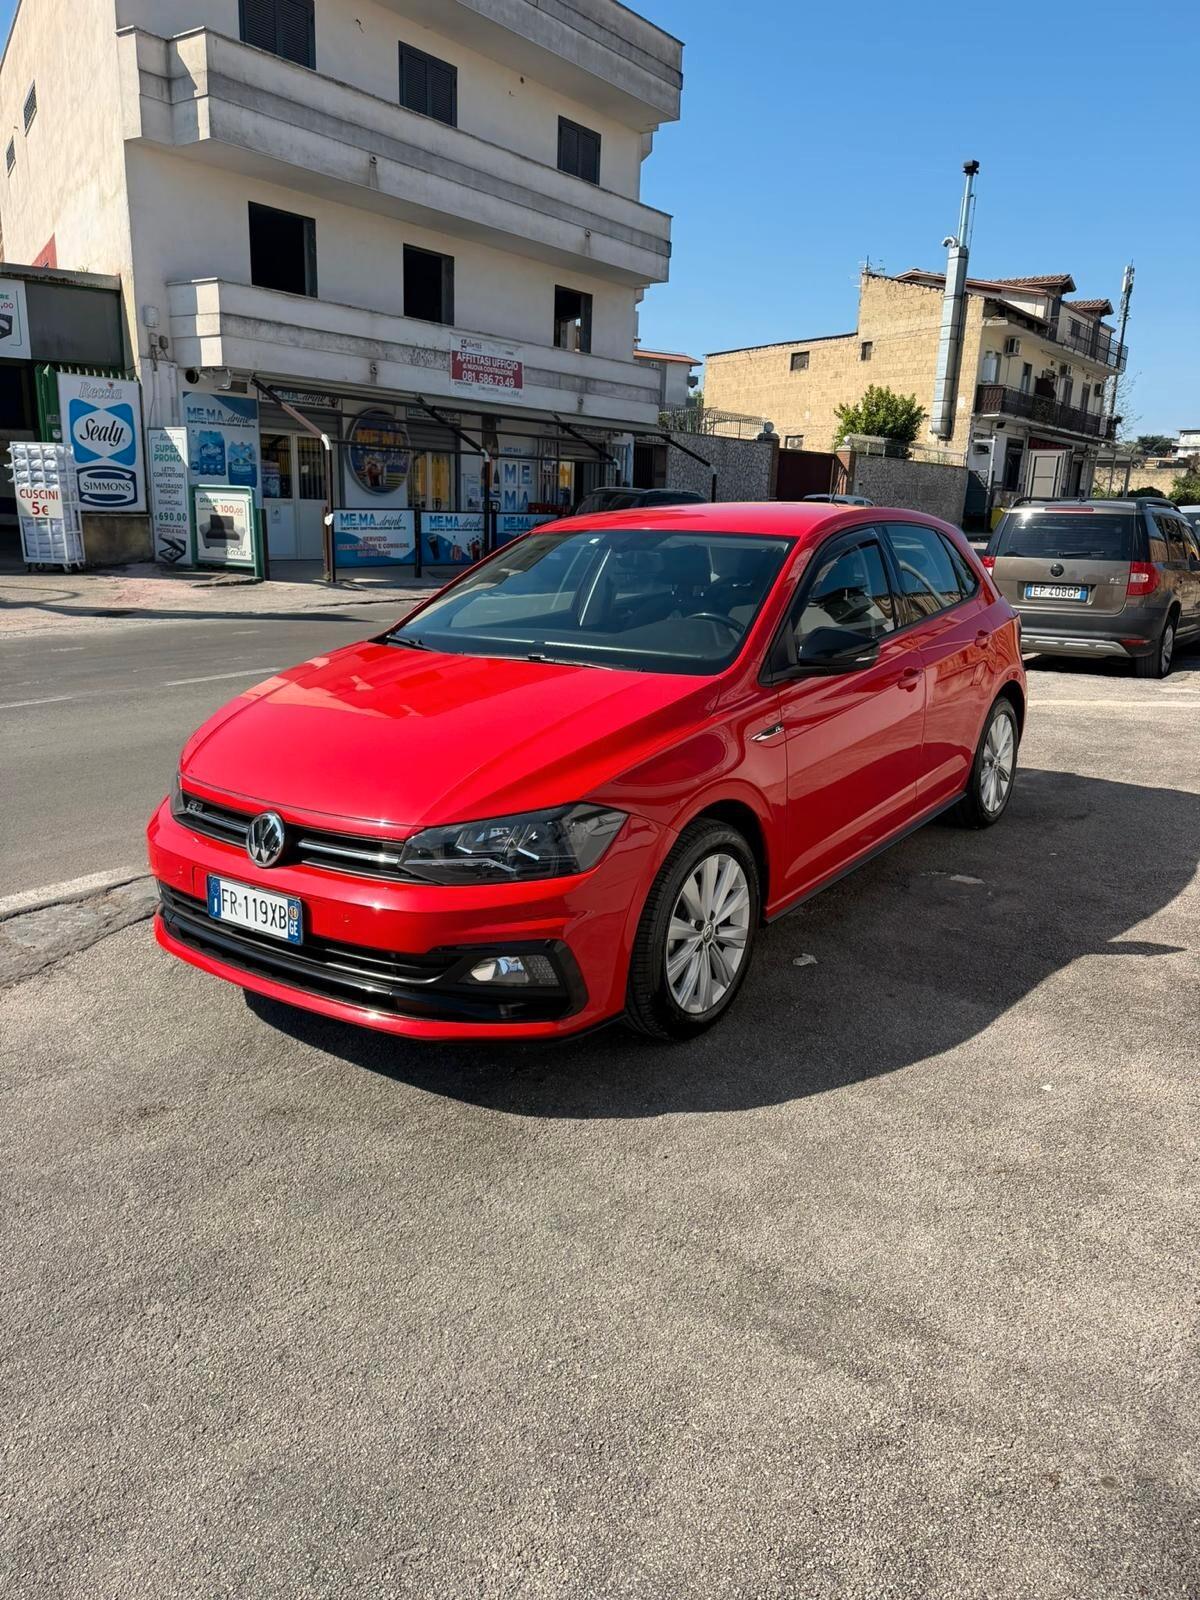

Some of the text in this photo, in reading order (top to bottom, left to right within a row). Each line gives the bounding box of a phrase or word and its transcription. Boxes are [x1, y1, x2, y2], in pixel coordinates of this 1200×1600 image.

[457, 352, 518, 371] AFFITTASI UFFICIO
[484, 367, 514, 376] COSTRUZIONE
[80, 418, 124, 447] Sealy
[153, 454, 182, 463] PROMO
[84, 481, 132, 491] SIMMONS
[20, 488, 59, 500] CUSCINI
[1033, 586, 1080, 597] EP 408GP
[221, 889, 238, 915] FR
[244, 896, 287, 929] 119XB
[289, 920, 299, 936] GE
